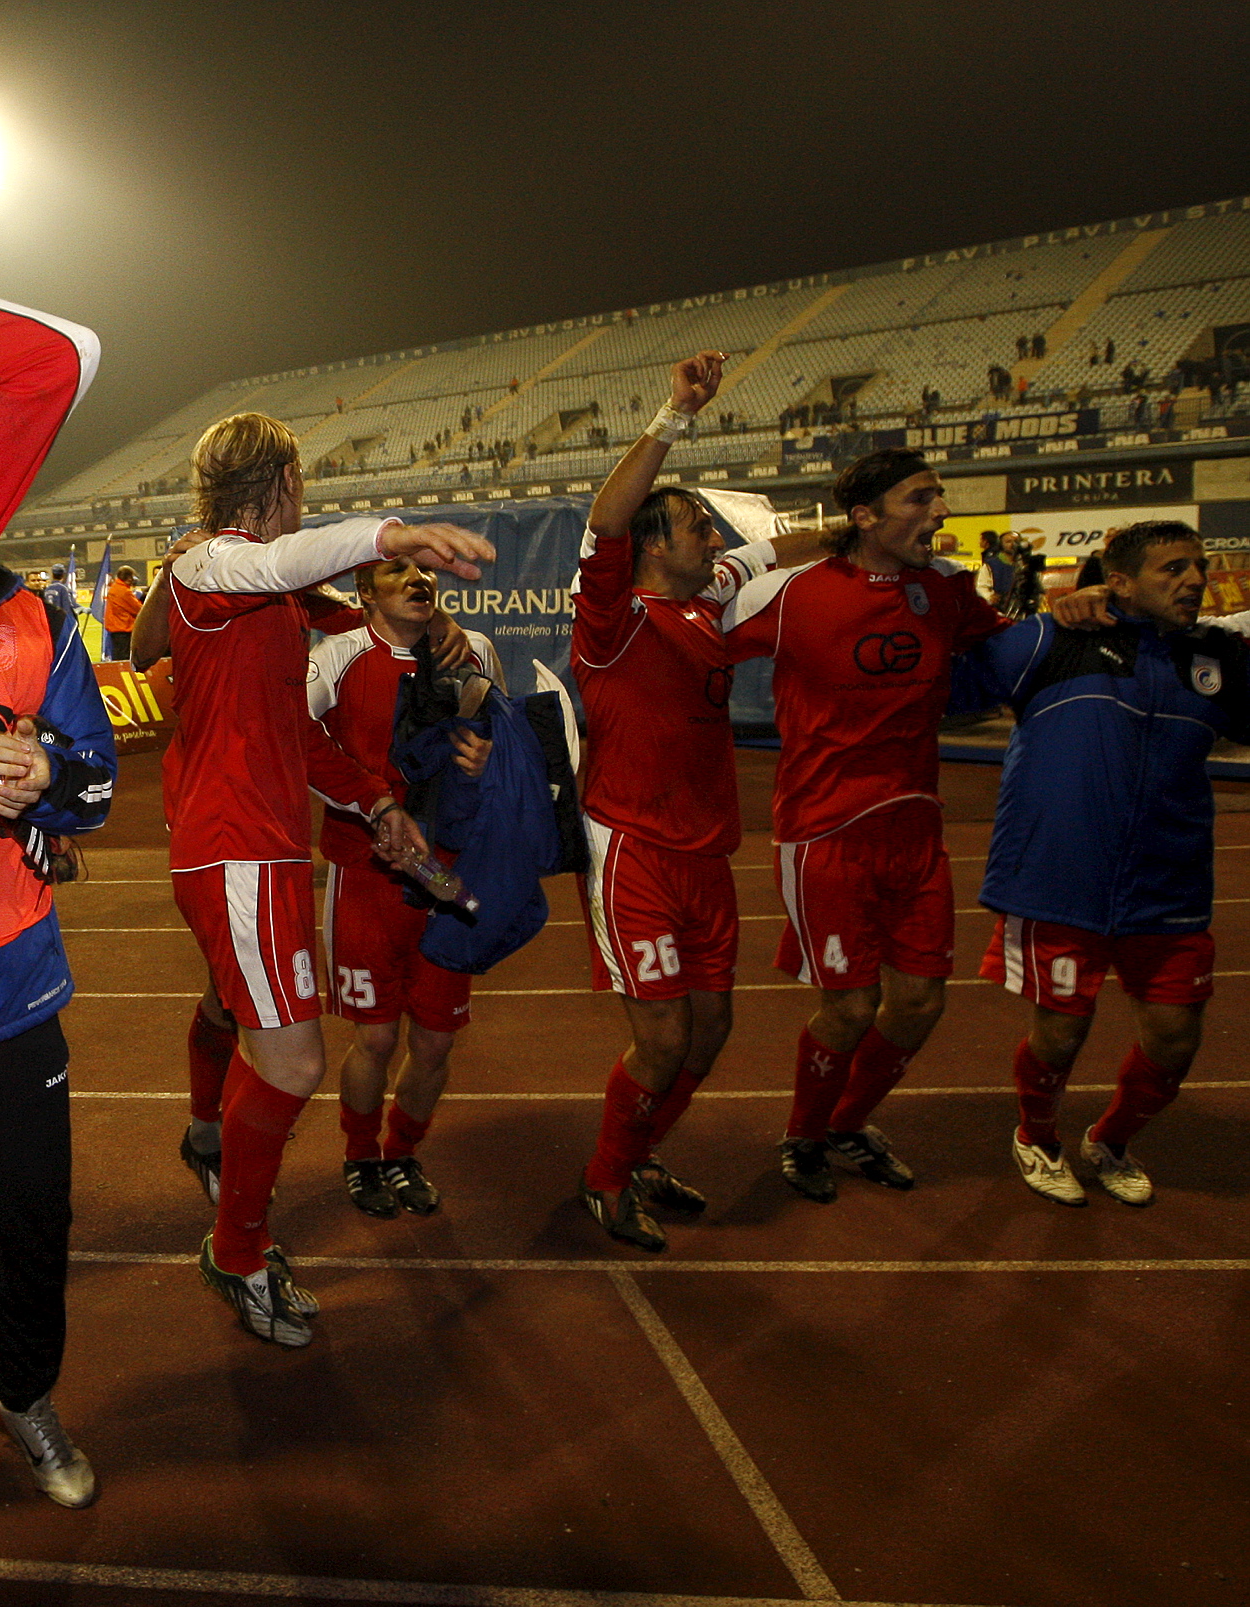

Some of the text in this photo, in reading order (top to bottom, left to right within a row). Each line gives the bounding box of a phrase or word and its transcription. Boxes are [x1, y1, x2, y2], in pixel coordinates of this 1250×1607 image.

[906, 425, 968, 448] BLUE
[1023, 467, 1175, 494] PRINTERA
[1056, 530, 1103, 547] TOP
[868, 574, 900, 583] JAKO
[435, 588, 575, 615] IGURANJE
[495, 623, 551, 639] utemeljeno
[631, 933, 681, 983] 26
[822, 933, 848, 974] 4
[292, 947, 315, 1000] 8
[337, 964, 376, 1009] 25
[1051, 956, 1077, 998] 9
